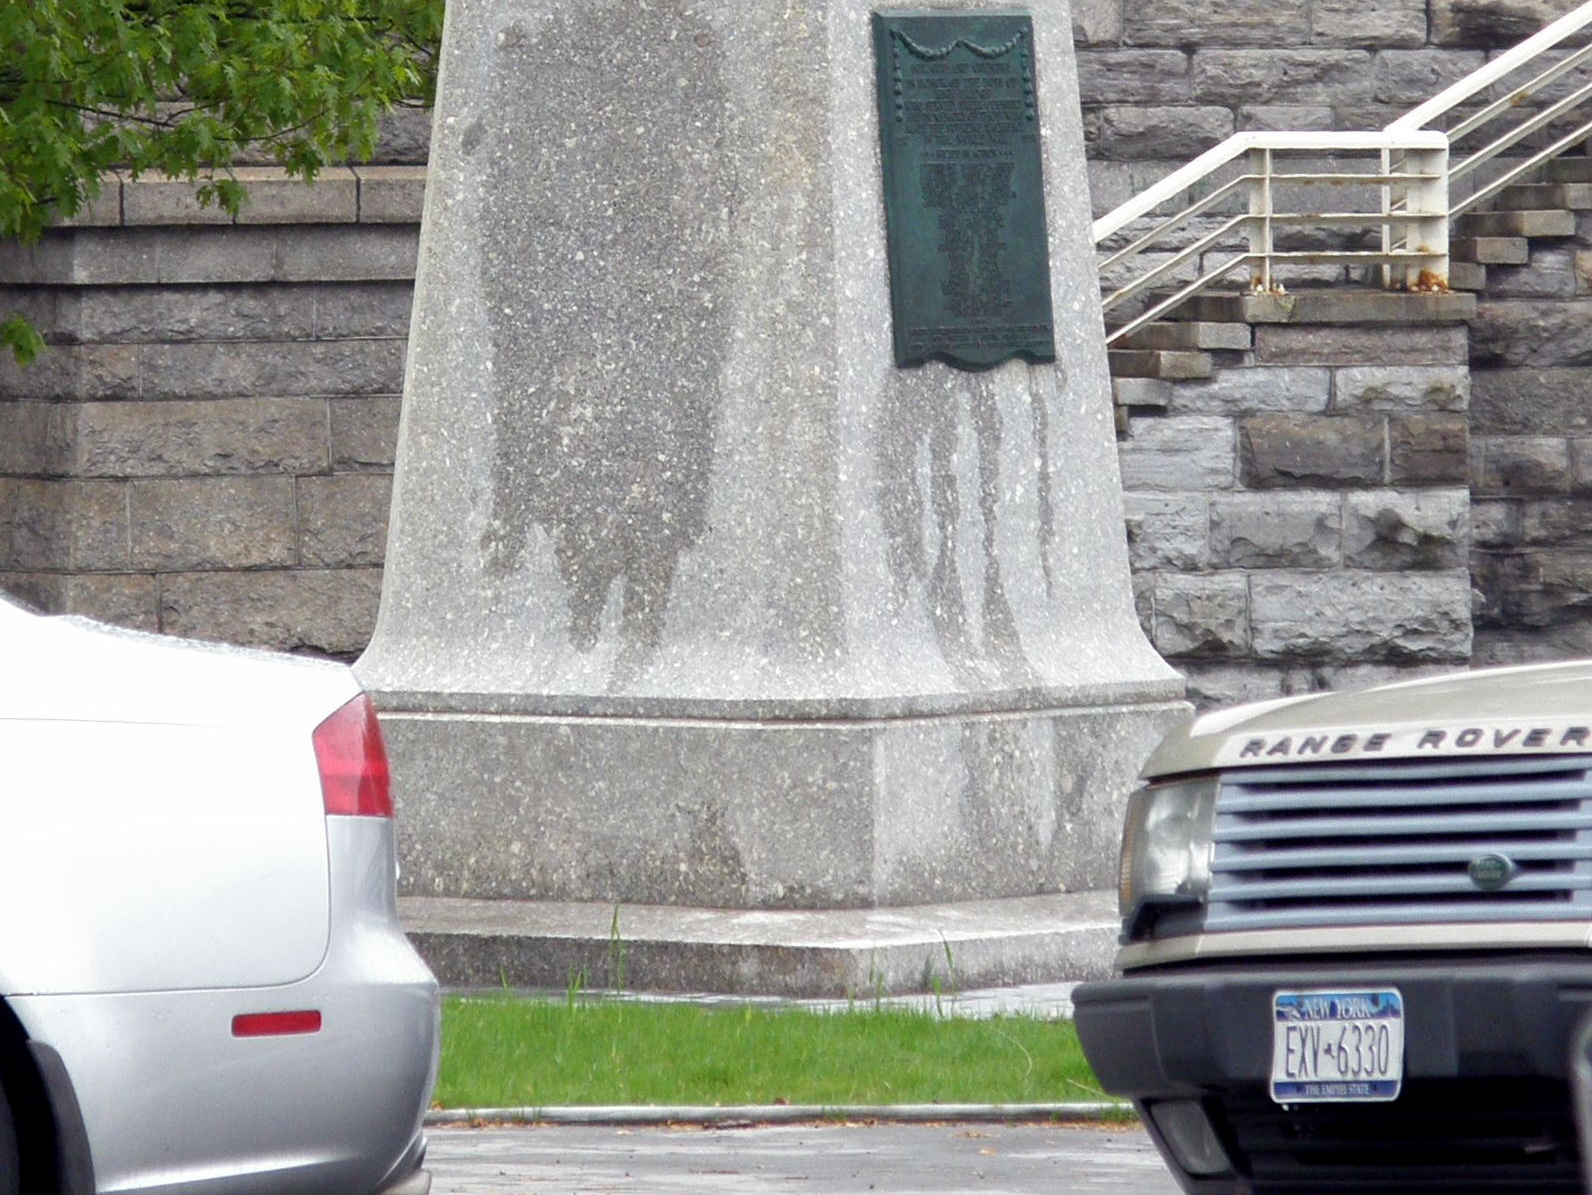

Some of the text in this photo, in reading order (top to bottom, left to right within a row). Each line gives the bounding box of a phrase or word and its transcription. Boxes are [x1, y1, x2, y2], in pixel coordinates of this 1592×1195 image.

[1239, 726, 1591, 758] RANGE ROVER
[1305, 997, 1372, 1018] NEW YORK
[1286, 1023, 1390, 1078] EXV 6330
